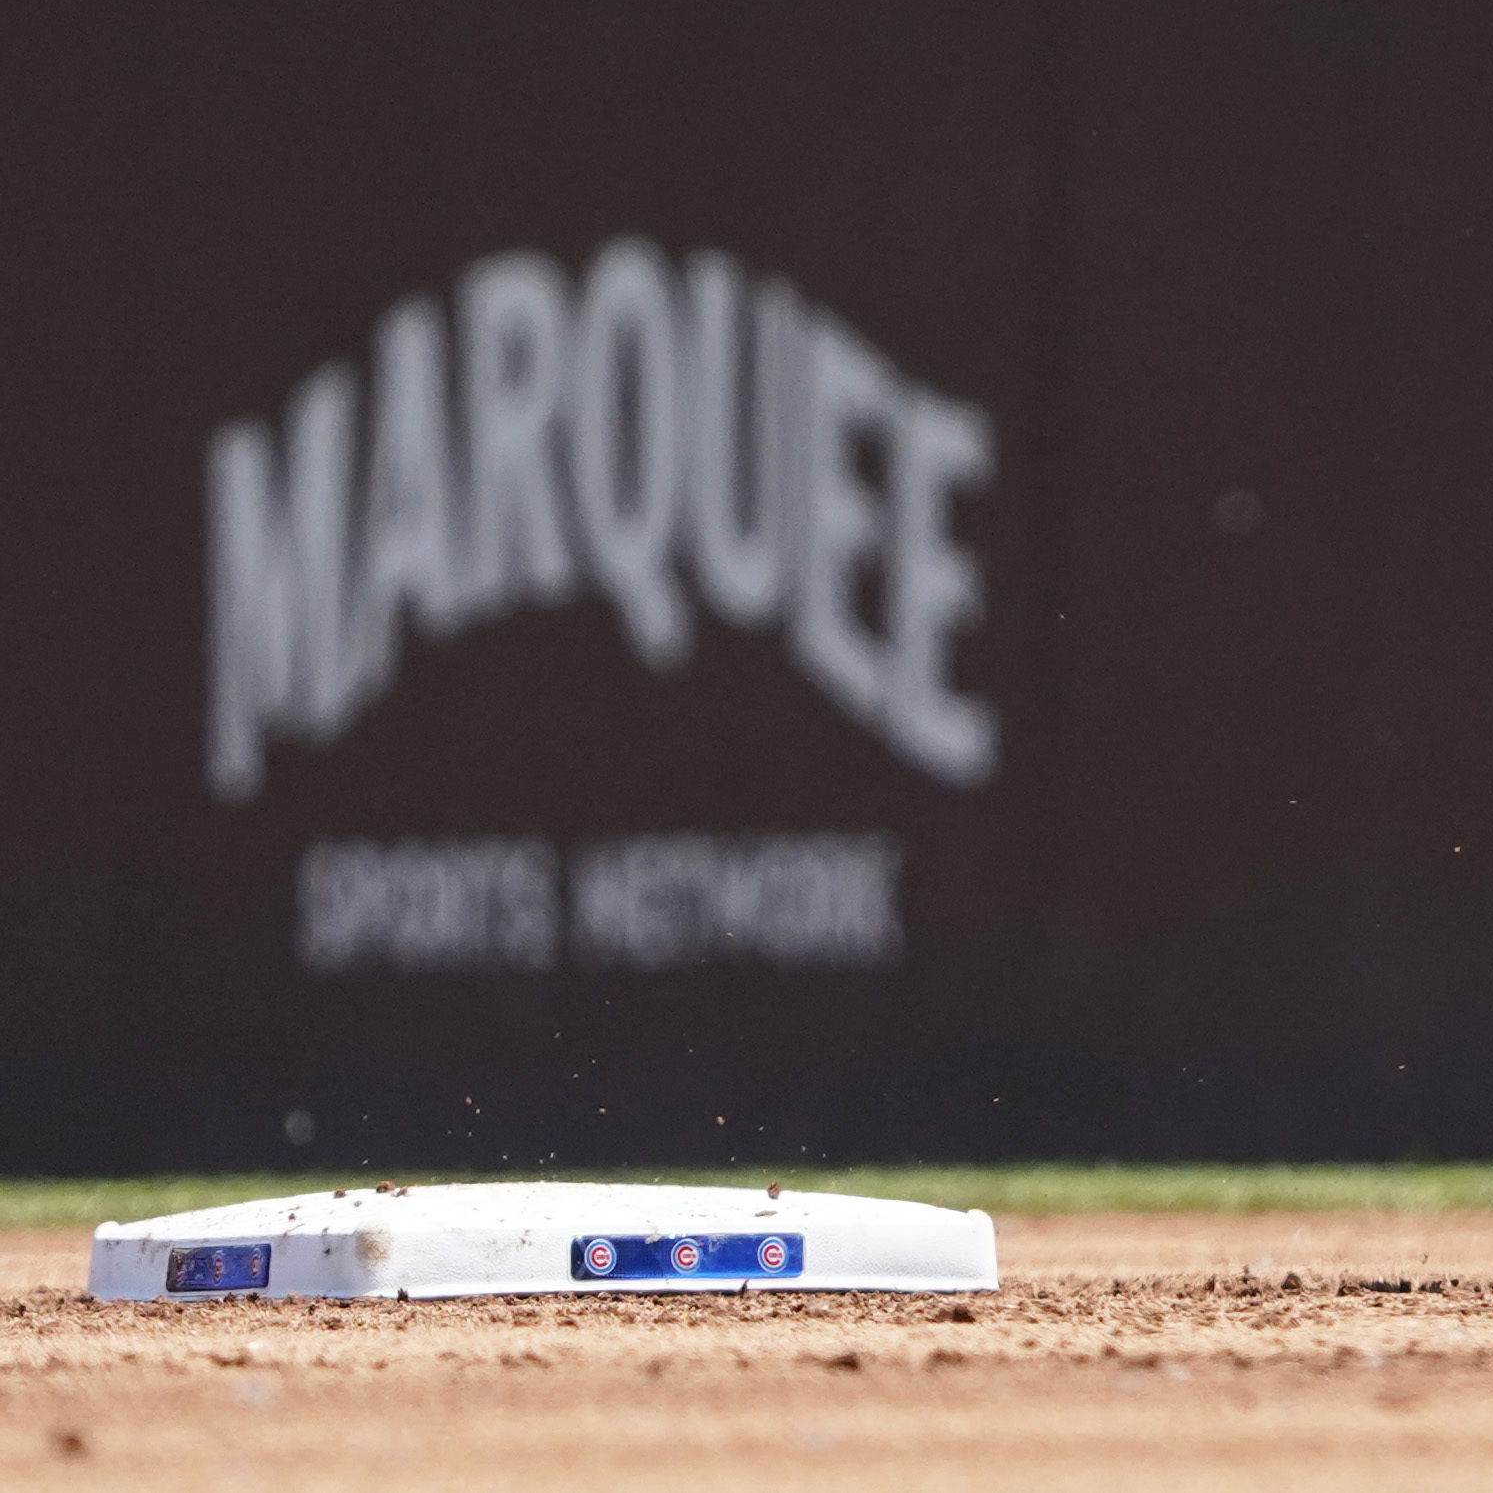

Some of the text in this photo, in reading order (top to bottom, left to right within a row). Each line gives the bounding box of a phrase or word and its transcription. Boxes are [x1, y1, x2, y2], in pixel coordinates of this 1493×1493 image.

[208, 238, 995, 793] MARQUEE
[303, 837, 896, 963] SPORTS NETWORK
